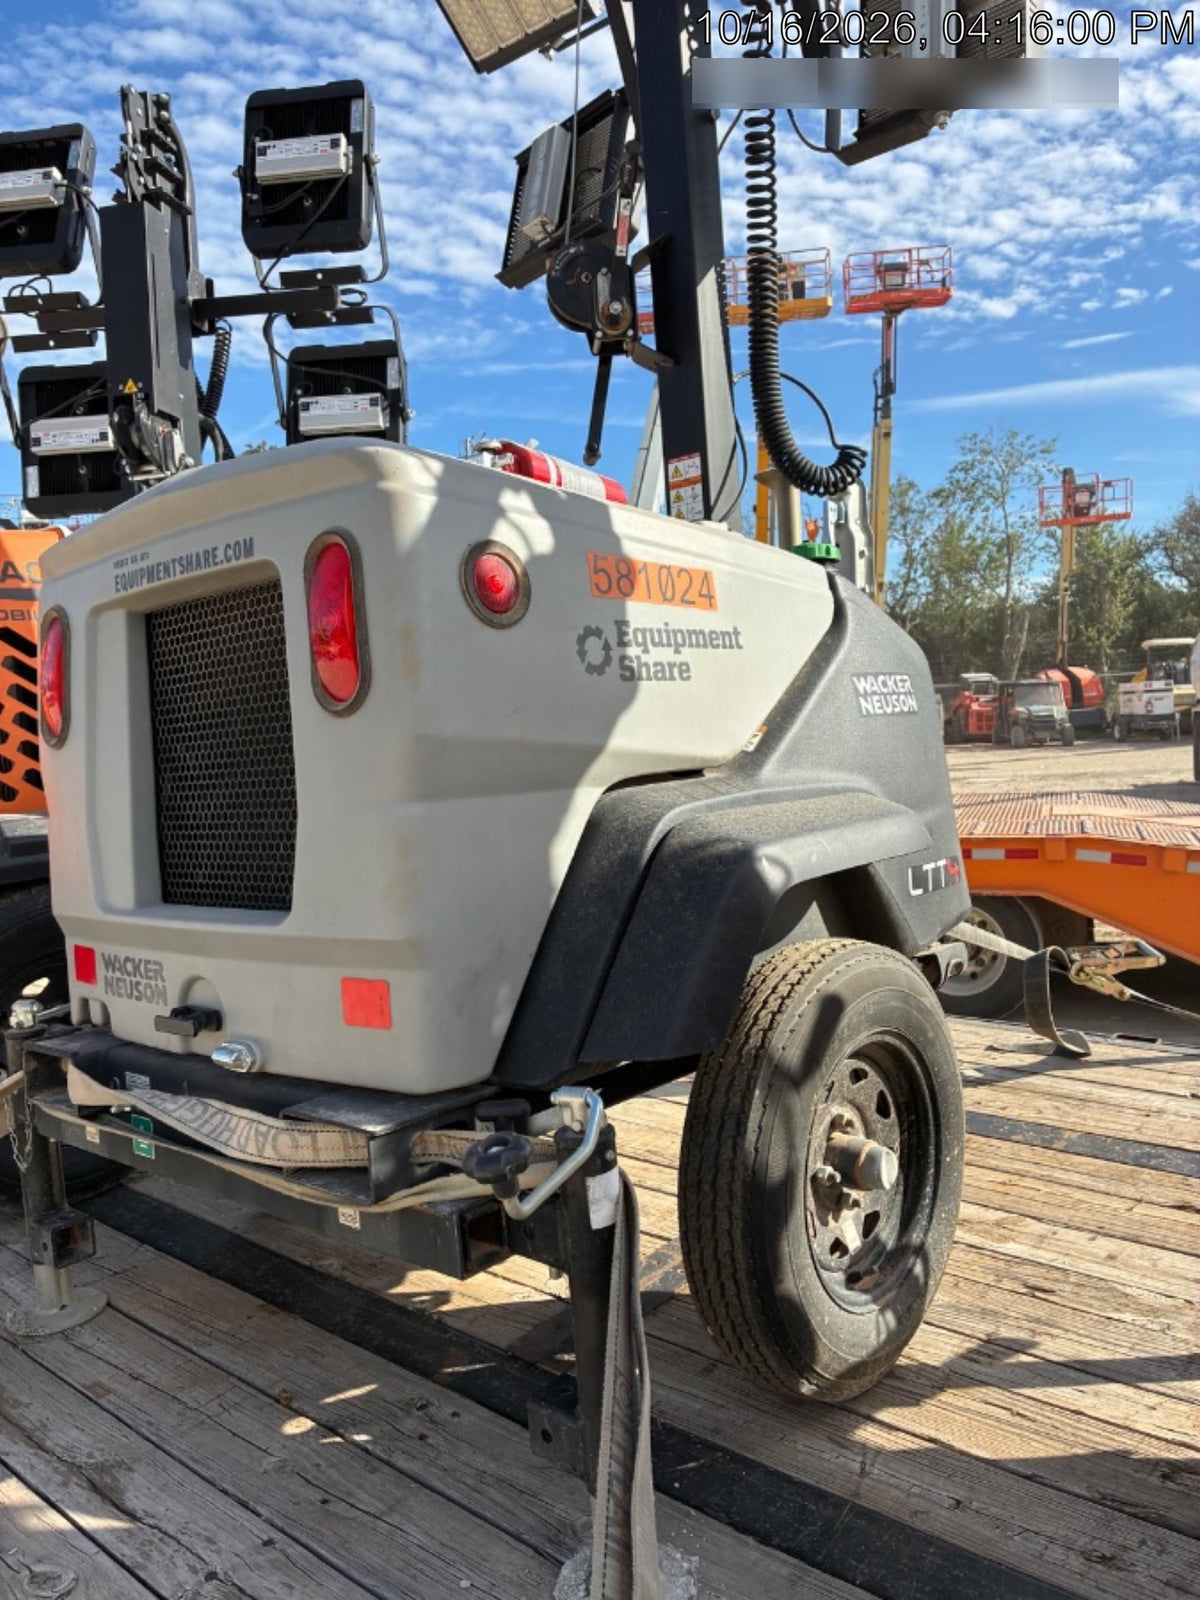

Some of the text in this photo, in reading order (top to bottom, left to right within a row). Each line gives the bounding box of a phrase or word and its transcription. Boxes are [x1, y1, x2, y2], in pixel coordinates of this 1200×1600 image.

[114, 536, 255, 593] EQUIPMENTSHARE.COM
[592, 553, 715, 608] 581024
[614, 620, 743, 654] Equipment
[618, 655, 691, 682] Share
[852, 675, 914, 694] WACKER
[859, 694, 918, 715] NEUSON
[101, 952, 166, 983] WACKER
[104, 974, 168, 1007] NEUSON
